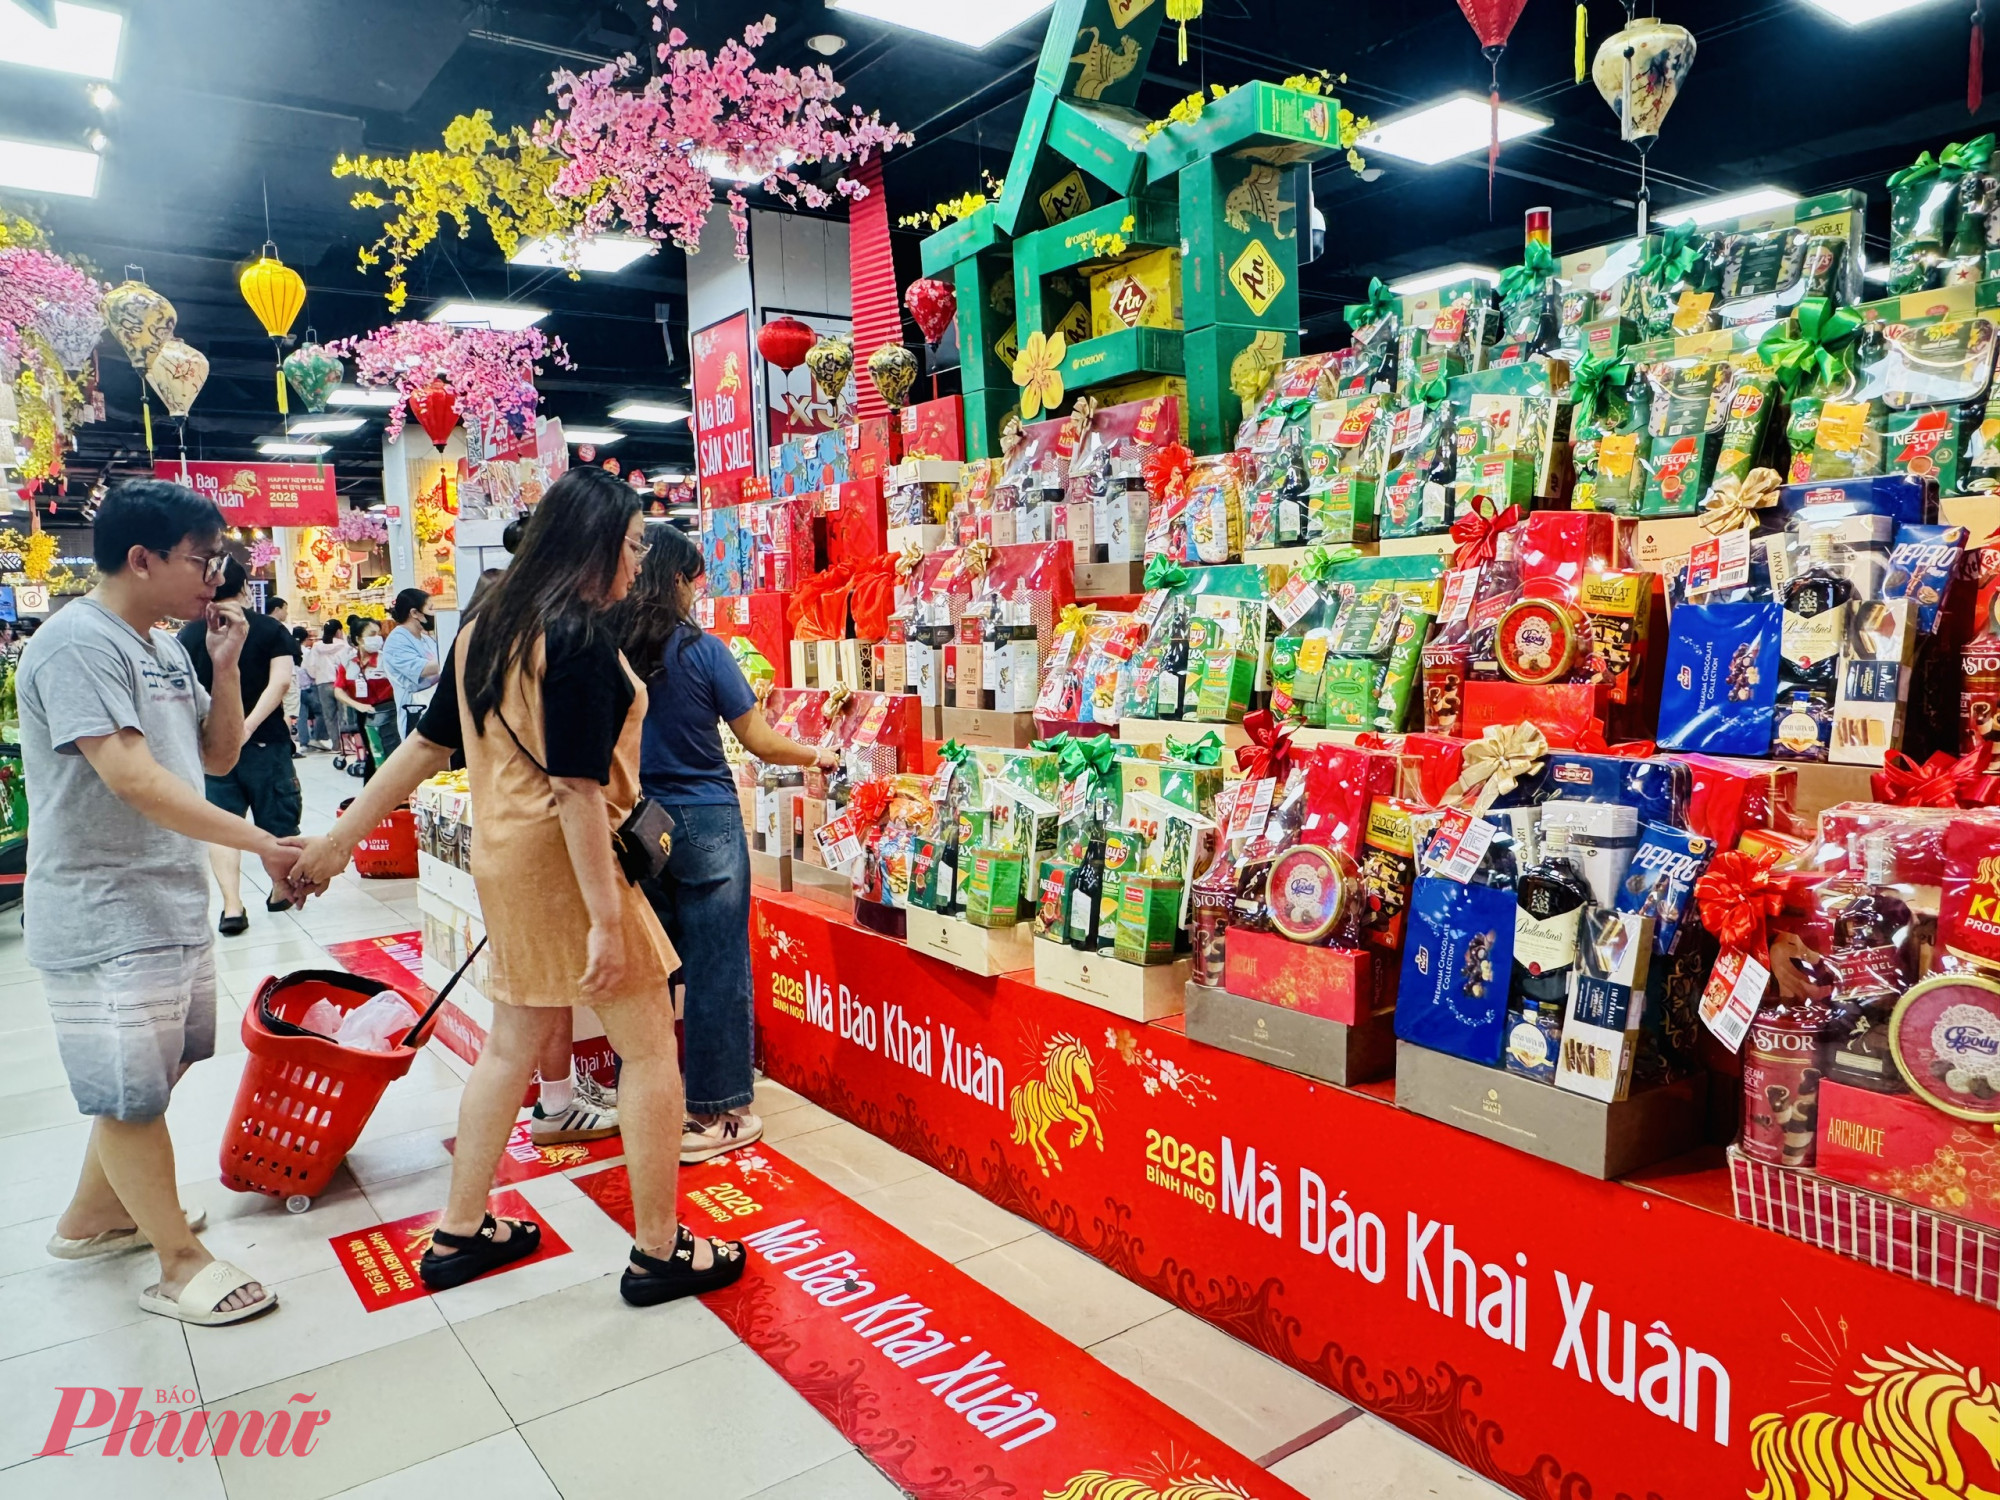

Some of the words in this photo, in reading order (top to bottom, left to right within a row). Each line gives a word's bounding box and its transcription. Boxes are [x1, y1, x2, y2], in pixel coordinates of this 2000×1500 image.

[1241, 254, 1264, 301] An
[1119, 291, 1143, 314] An
[1435, 319, 1459, 331] KEY
[1080, 353, 1105, 368] ORION
[1732, 393, 1762, 409] Lay's
[1342, 421, 1368, 434] KEY
[1893, 429, 1954, 446] NESCAFE
[701, 436, 723, 478] SĂN
[725, 428, 752, 471] SALE
[1653, 453, 1699, 466] NESCAFE
[269, 492, 298, 502] 2026
[1386, 484, 1417, 494] ESCAFE
[1890, 542, 1961, 568] PEPERO
[1586, 584, 1631, 598] CHOCOLAT
[1111, 630, 1135, 648] 10+1
[1707, 657, 1718, 700] COLLECTION
[1630, 841, 1702, 882] PEPERO
[1968, 894, 2000, 924] KE
[1964, 917, 2000, 937] PROD
[1437, 923, 1450, 970] CHOCOLATE
[1442, 942, 1455, 991] COLLECTION
[772, 972, 804, 1006] 2026
[1432, 971, 1444, 1005] PREMIUM
[790, 1006, 805, 1024] NGỌ
[1607, 988, 1619, 1026] IMPERIAL
[804, 969, 834, 1033] Mã
[838, 983, 877, 1052] Đáo
[882, 1001, 932, 1078] Khai
[939, 1022, 1004, 1112] Xuân
[1944, 1025, 2000, 1056] Goody
[1827, 1117, 1885, 1158] ARCHCAFÉ
[1145, 1128, 1216, 1187] 2026
[703, 1182, 763, 1217] 2026
[1145, 1163, 1182, 1193] BÍNH
[1183, 1182, 1217, 1214] NGỌ
[705, 1205, 734, 1224] NGỌ
[740, 1218, 826, 1265] Mã
[367, 1231, 391, 1257] HAPPY
[380, 1250, 403, 1271] NEW
[393, 1266, 415, 1292] YEAR
[782, 1250, 876, 1307] Đáo
[1220, 1136, 1283, 1239] Mã
[1299, 1167, 1387, 1284] Đáo
[1407, 1211, 1528, 1351] Khai
[1551, 1269, 1731, 1447] Xuân
[840, 1293, 973, 1369] Khai
[916, 1350, 1057, 1452] Xuân
